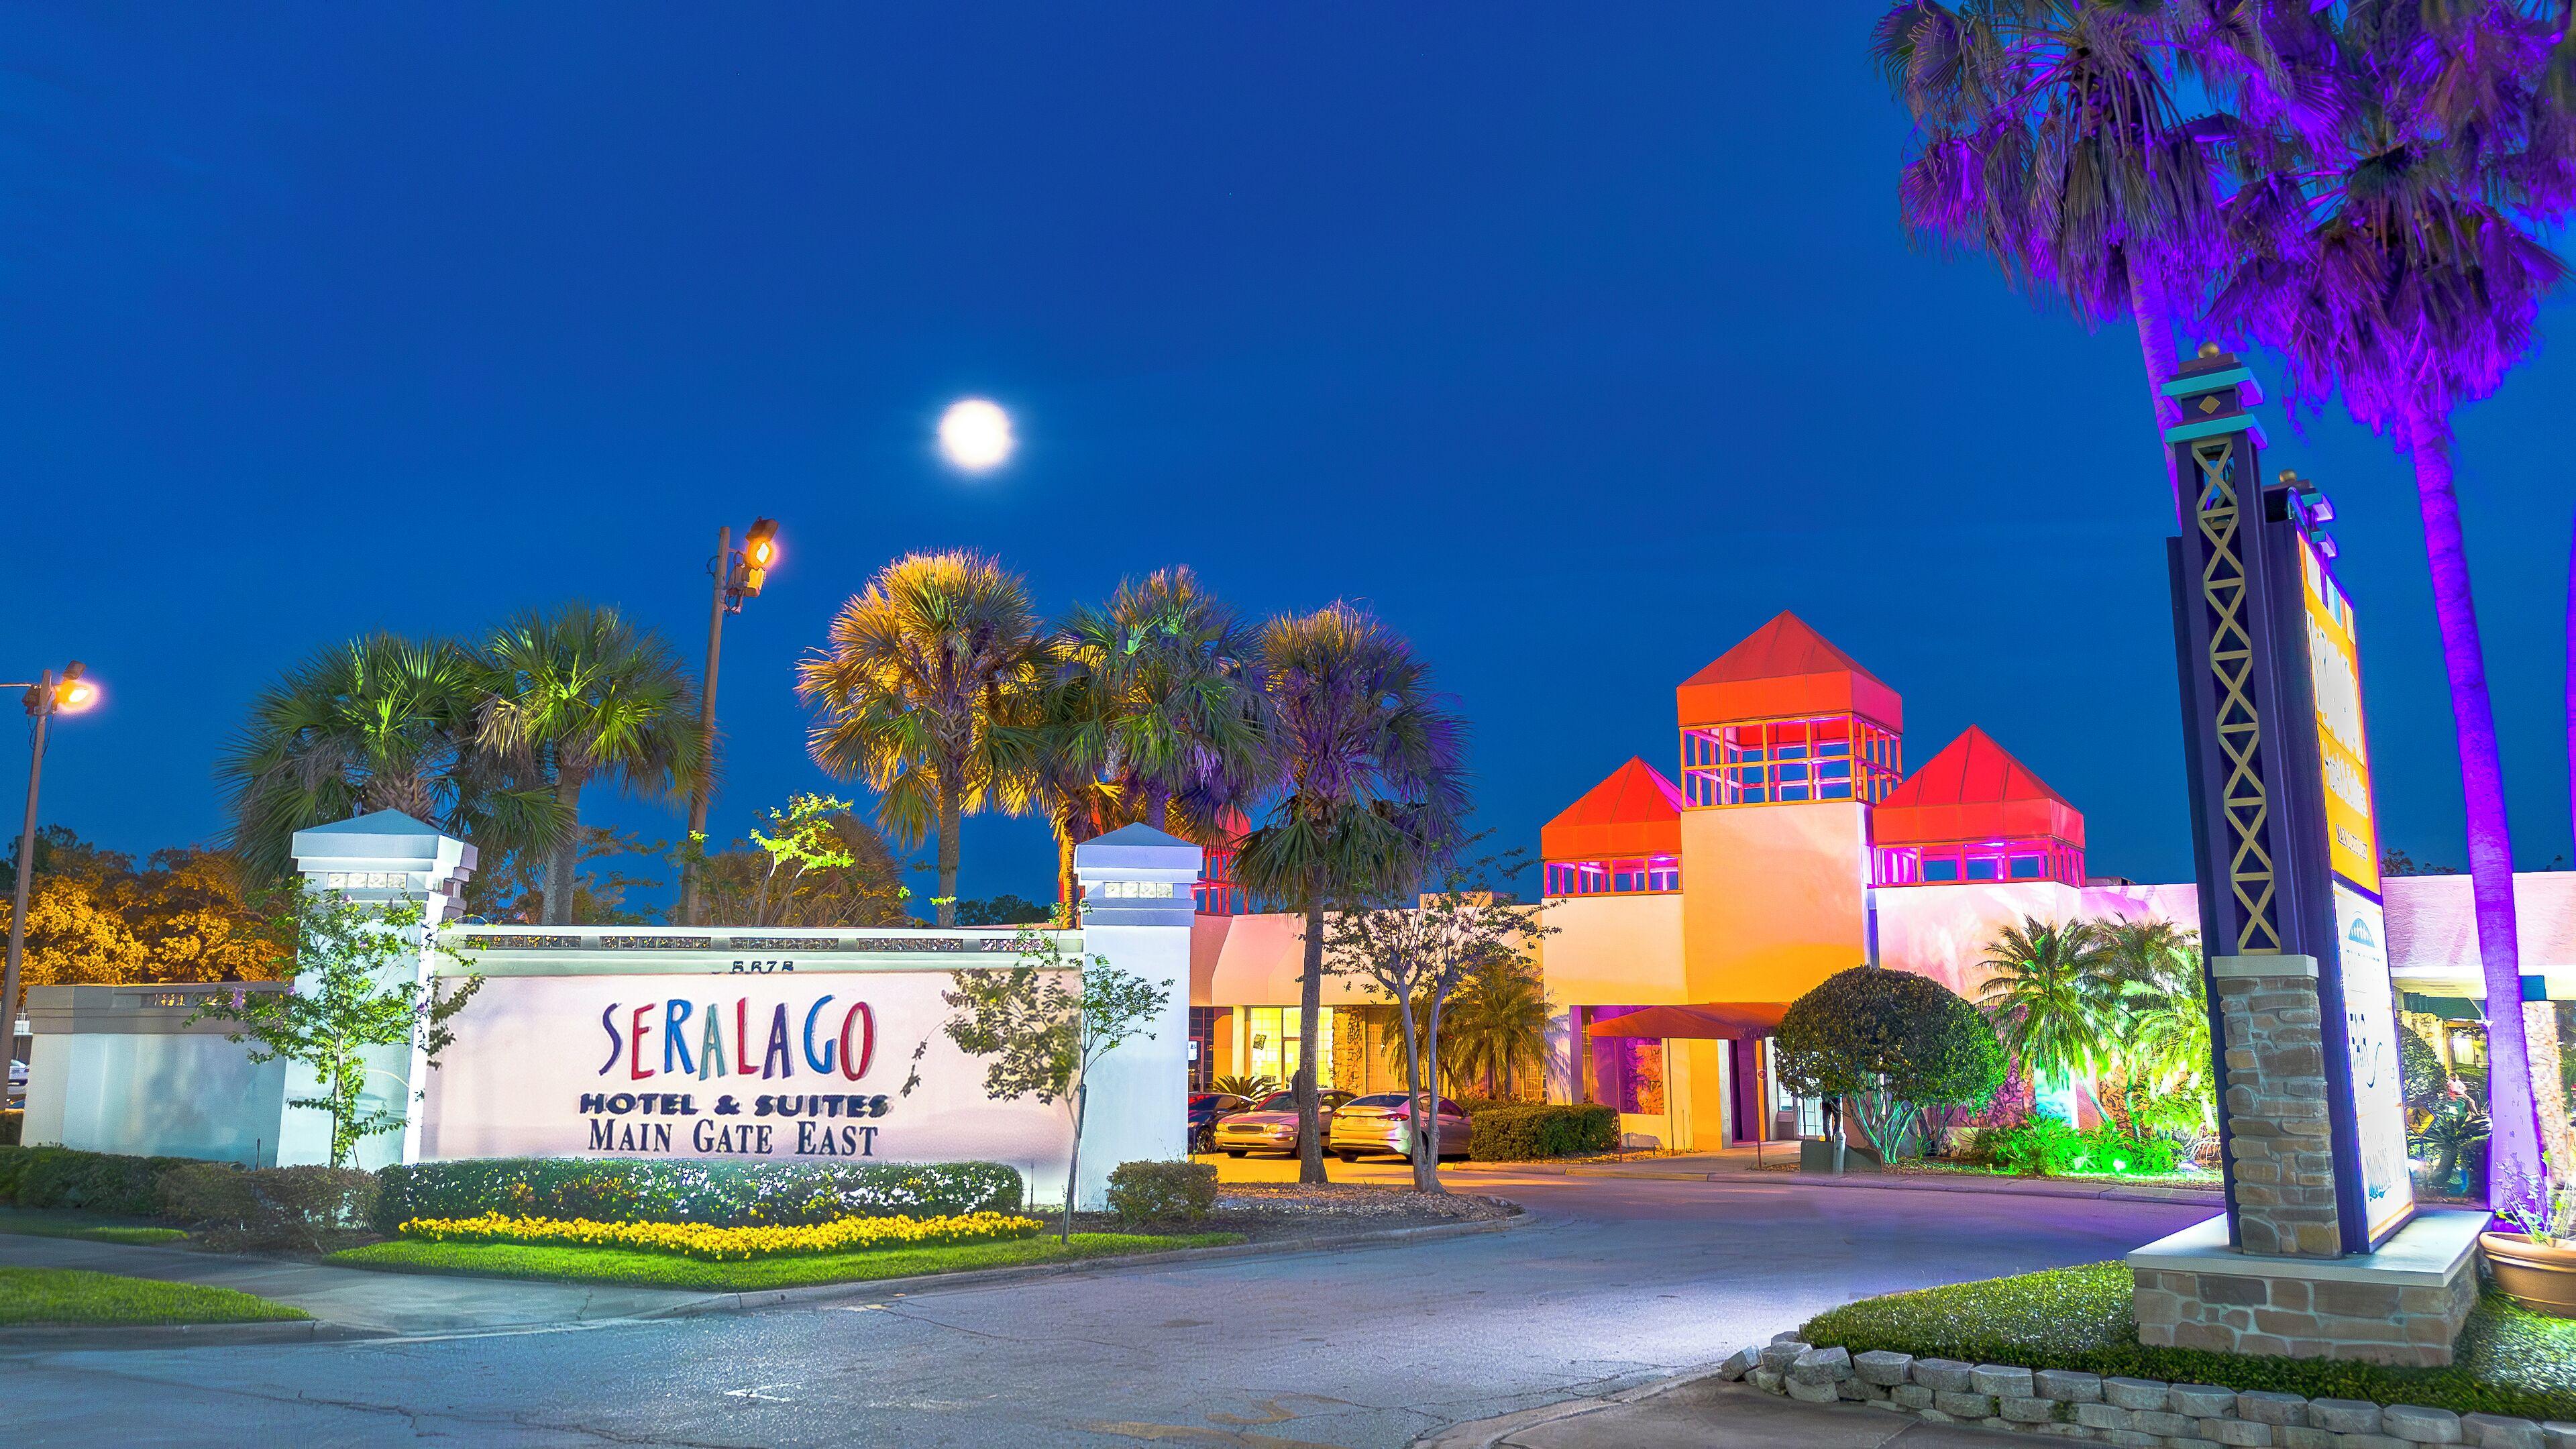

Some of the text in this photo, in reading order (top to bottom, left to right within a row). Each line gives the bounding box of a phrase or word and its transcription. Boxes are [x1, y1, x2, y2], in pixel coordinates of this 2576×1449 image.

[599, 994, 877, 1081] SERALAGO
[579, 1093, 891, 1118] HOTEL & SUITES
[588, 1118, 878, 1157] MAIN GATE EAST
